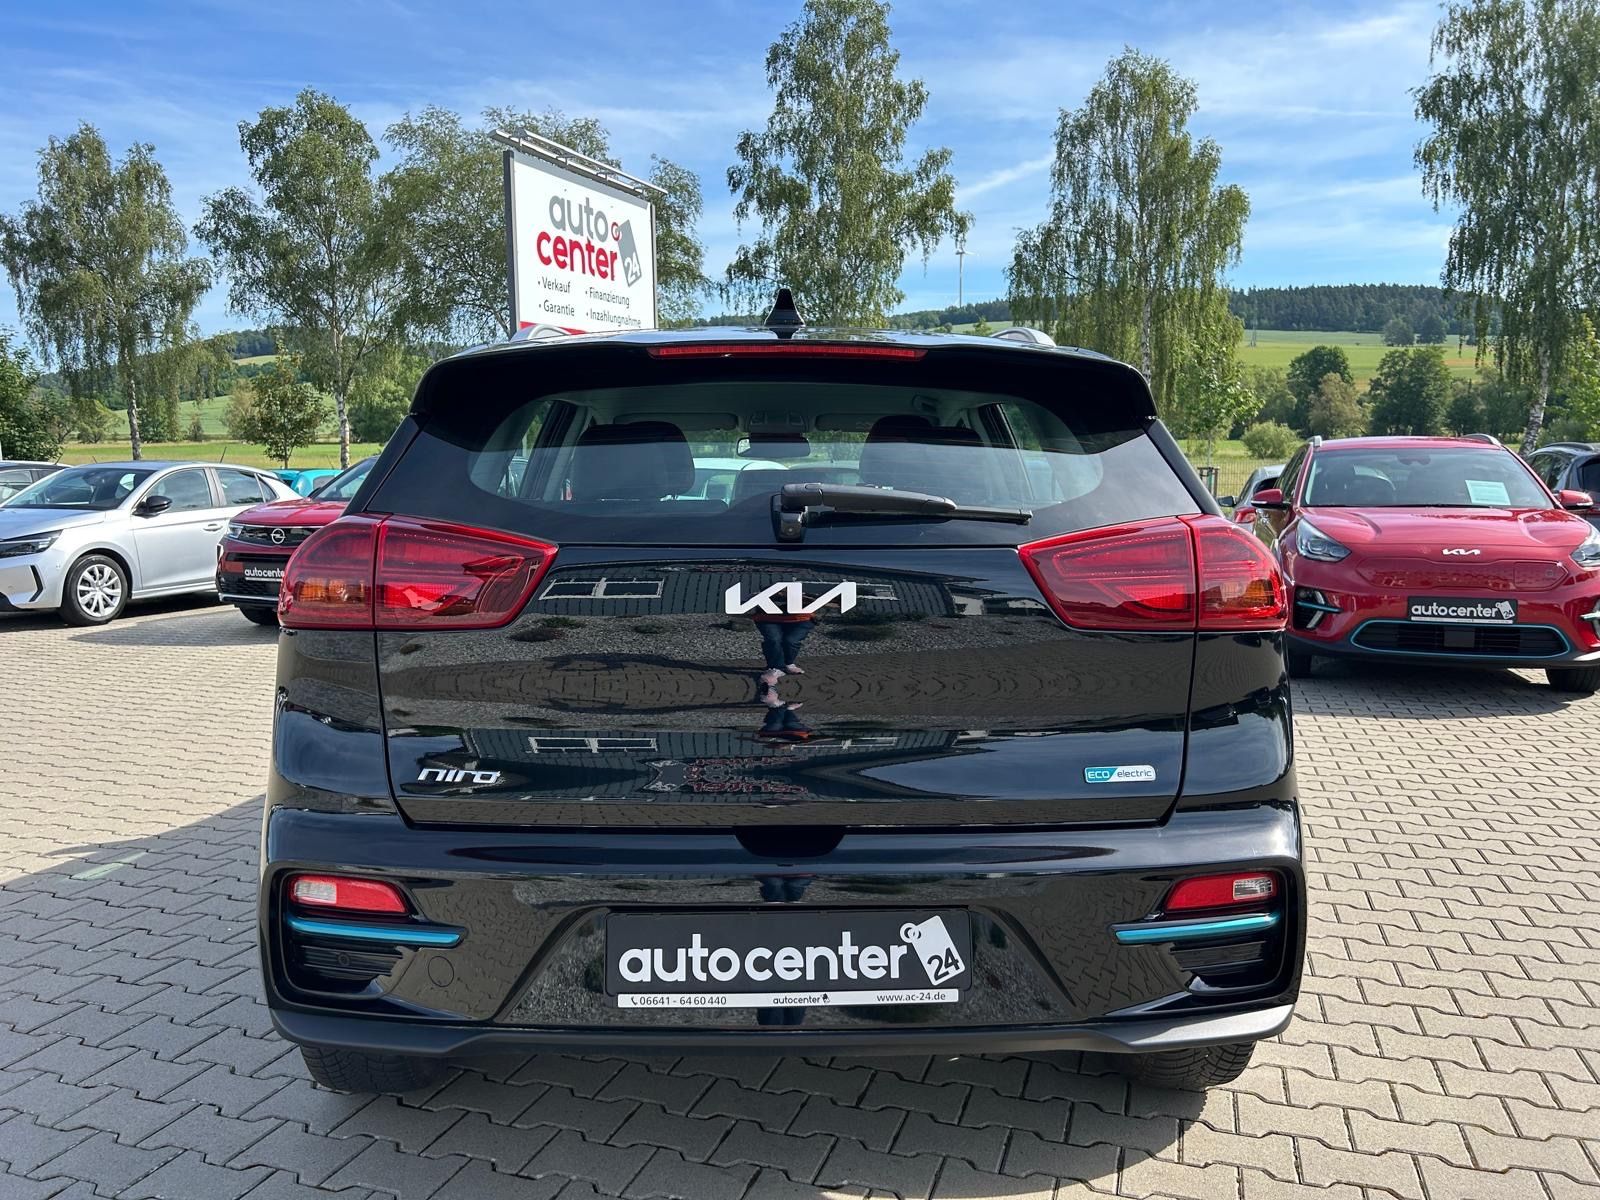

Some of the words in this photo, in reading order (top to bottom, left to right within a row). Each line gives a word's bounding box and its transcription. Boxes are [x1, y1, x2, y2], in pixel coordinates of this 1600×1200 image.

[549, 195, 609, 242] auto
[536, 231, 618, 281] center
[624, 252, 640, 282] 24
[542, 276, 571, 294] Verkauf
[589, 287, 630, 309] Finanzierung
[543, 300, 575, 317] Garantie
[590, 310, 641, 328] Inzahlungnahme
[245, 567, 285, 577] autocente
[725, 581, 857, 615] KIA
[417, 768, 501, 785] niro
[1087, 770, 1110, 779] ECO
[1117, 769, 1152, 778] electric
[927, 947, 960, 982] 24
[639, 996, 670, 1006] 06641
[772, 995, 820, 1004] autocenter
[876, 992, 946, 1002] www.ac-24.de
